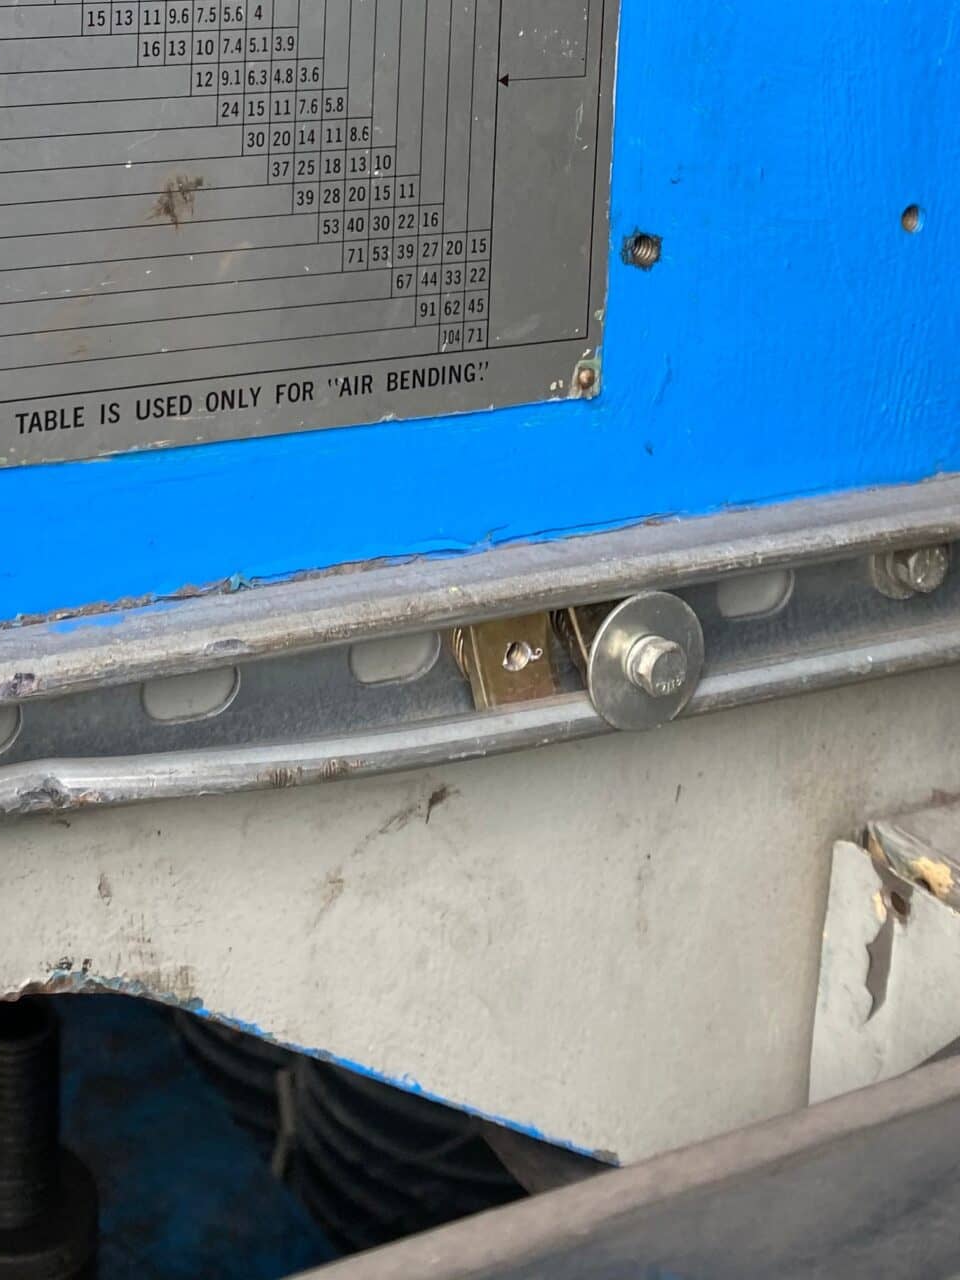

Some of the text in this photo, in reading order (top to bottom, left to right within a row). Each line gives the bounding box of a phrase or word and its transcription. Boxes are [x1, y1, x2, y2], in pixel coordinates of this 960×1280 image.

[143, 41, 160, 57] 16
[168, 40, 186, 56] 13
[196, 39, 214, 55] 10
[223, 38, 242, 54] 7.4
[249, 37, 268, 53] 5.1
[275, 36, 295, 52] 3.9
[221, 101, 239, 118] 24
[248, 100, 265, 117] 15
[274, 99, 291, 116] 11
[299, 98, 318, 114] 7.6
[325, 97, 344, 113] 5.8
[272, 161, 290, 177] 37
[297, 160, 315, 176] 25
[325, 158, 341, 174] 18
[350, 156, 366, 173] 13
[375, 154, 391, 170] 10
[323, 219, 339, 235] 53
[347, 217, 364, 232] 40
[373, 215, 390, 231] 30
[398, 214, 414, 229] 22
[423, 212, 438, 227] 16
[396, 273, 413, 289] 67
[421, 272, 437, 287] 44
[445, 270, 461, 286] 33
[470, 267, 486, 283] 22
[420, 302, 436, 318] 91
[444, 300, 460, 316] 62
[468, 298, 484, 313] 45
[443, 329, 460, 344] 104
[468, 328, 483, 343] 71
[15, 406, 85, 434] TABLE
[100, 402, 120, 425] IS
[136, 394, 192, 420] USED
[205, 386, 261, 412] ONLY
[276, 381, 314, 405] FOR
